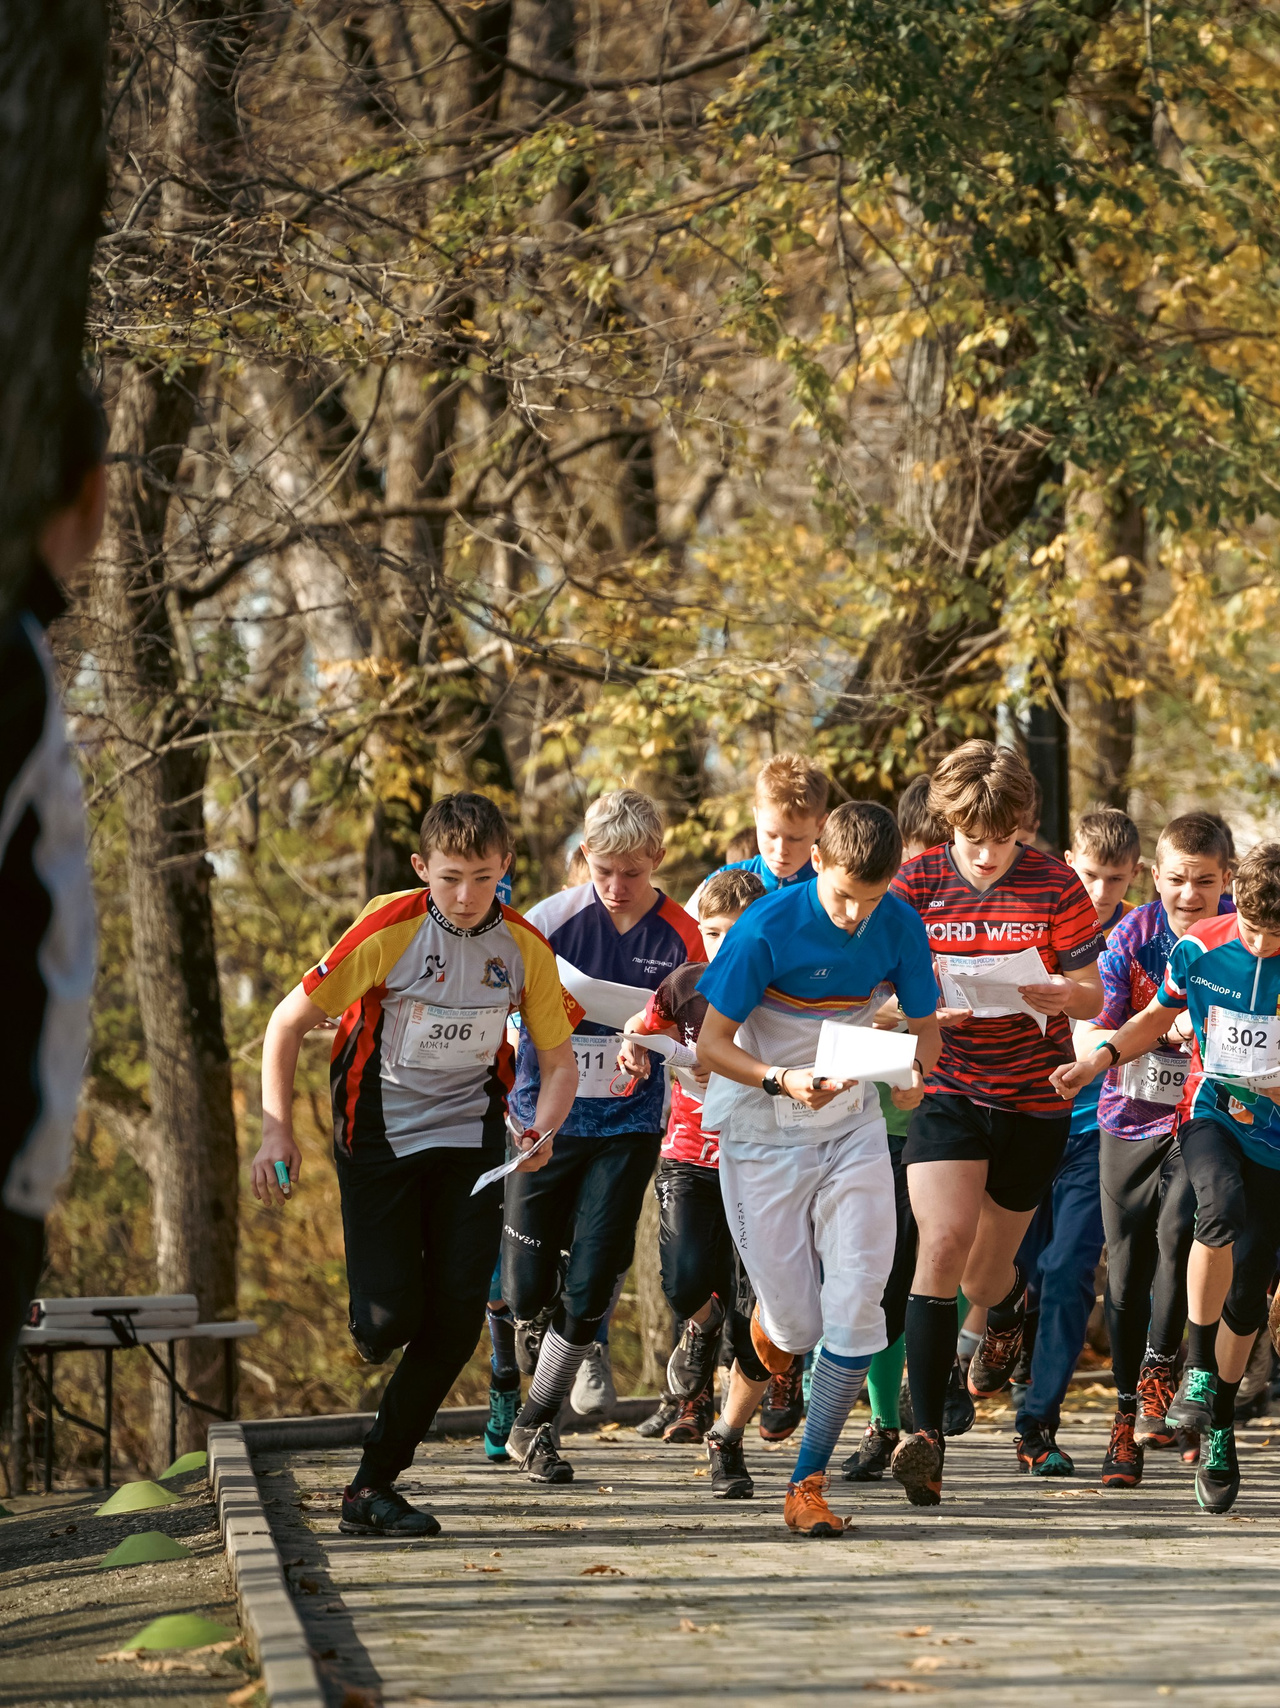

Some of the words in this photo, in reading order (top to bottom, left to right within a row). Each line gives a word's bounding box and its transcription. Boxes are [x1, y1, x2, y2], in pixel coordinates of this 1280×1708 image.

[983, 922, 1048, 942] WEST
[1190, 975, 1230, 995] СДЮСШОР
[1231, 990, 1242, 999] 18
[428, 1023, 473, 1041] 306
[480, 1030, 485, 1041] 1
[1228, 1026, 1267, 1049] 302
[1276, 1040, 1280, 1050] 1
[420, 1041, 449, 1049] МЖ14
[1221, 1043, 1247, 1055] МЖ14
[1140, 1079, 1165, 1092] МЖ14
[1147, 1067, 1185, 1087] 309
